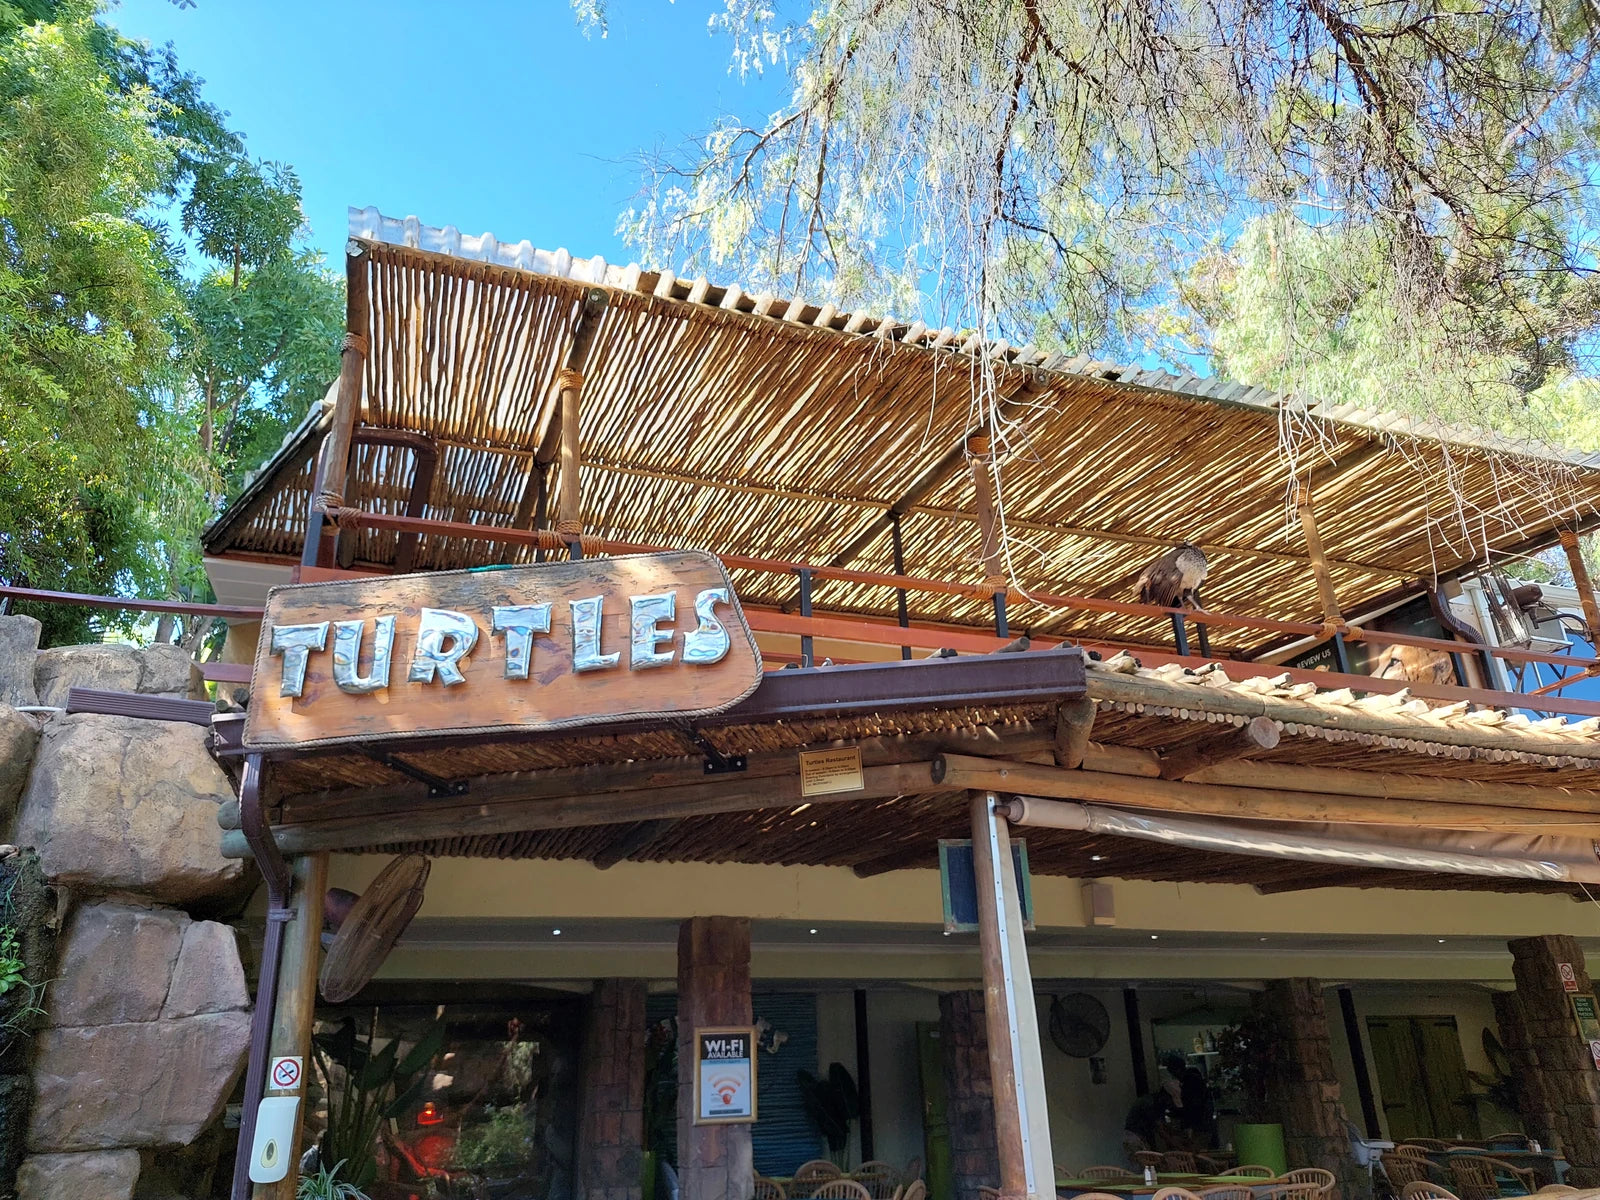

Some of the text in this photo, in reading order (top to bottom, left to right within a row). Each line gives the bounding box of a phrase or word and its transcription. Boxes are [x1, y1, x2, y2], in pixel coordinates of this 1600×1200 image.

[270, 588, 731, 698] TURTLES
[1297, 649, 1332, 669] REVIEW US
[825, 755, 856, 763] Restaurant
[705, 1039, 744, 1052] WI-FI
[707, 1050, 744, 1059] AVAILABLE
